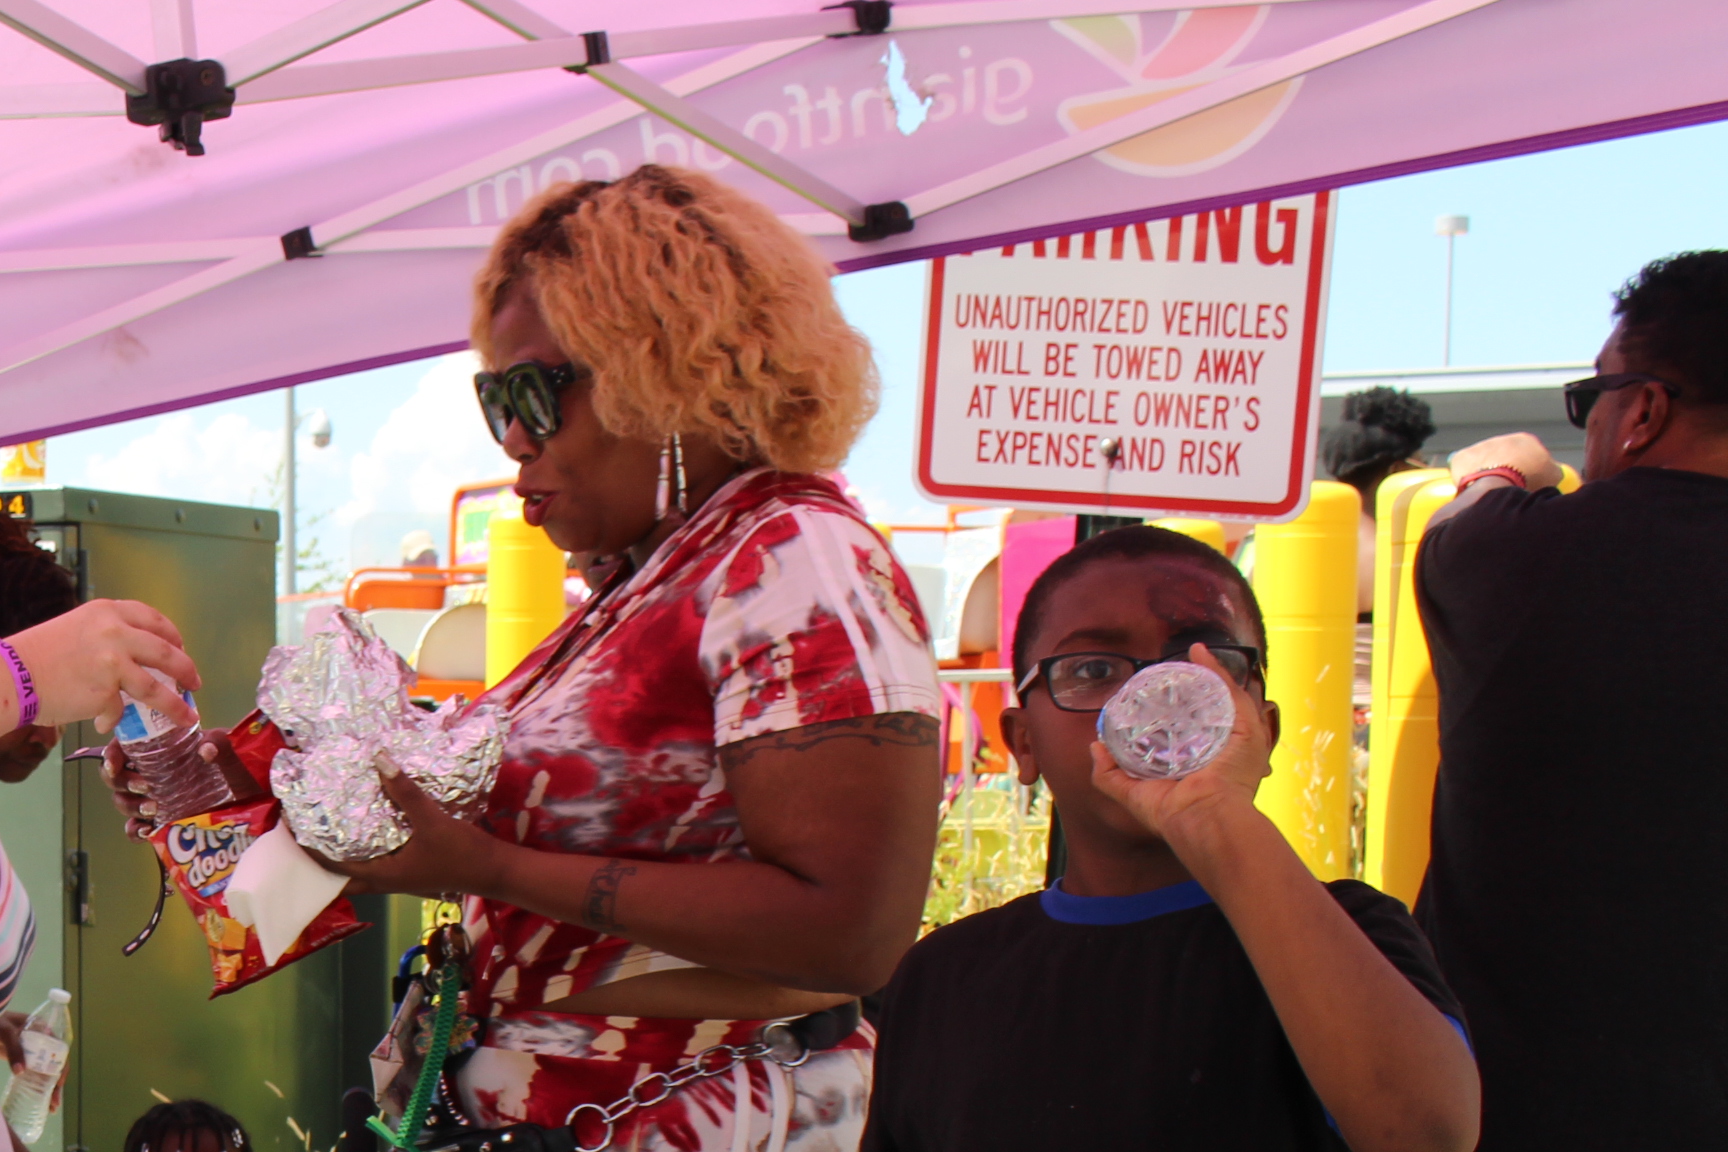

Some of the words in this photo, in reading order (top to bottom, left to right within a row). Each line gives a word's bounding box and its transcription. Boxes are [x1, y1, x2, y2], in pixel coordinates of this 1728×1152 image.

[954, 293, 1149, 334] UNAUTHORIZED
[1162, 300, 1289, 340] VEHICLES
[971, 339, 1031, 376] WILL
[1043, 343, 1079, 378] BE
[1092, 344, 1183, 382] TOWED
[1194, 348, 1265, 386] AWAY
[966, 385, 997, 419] AT
[1009, 386, 1120, 425] VEHICLE
[1133, 391, 1262, 432] OWNER'S
[976, 429, 1099, 469] EXPENSE
[1107, 437, 1166, 473] AND
[1178, 439, 1243, 477] RISK
